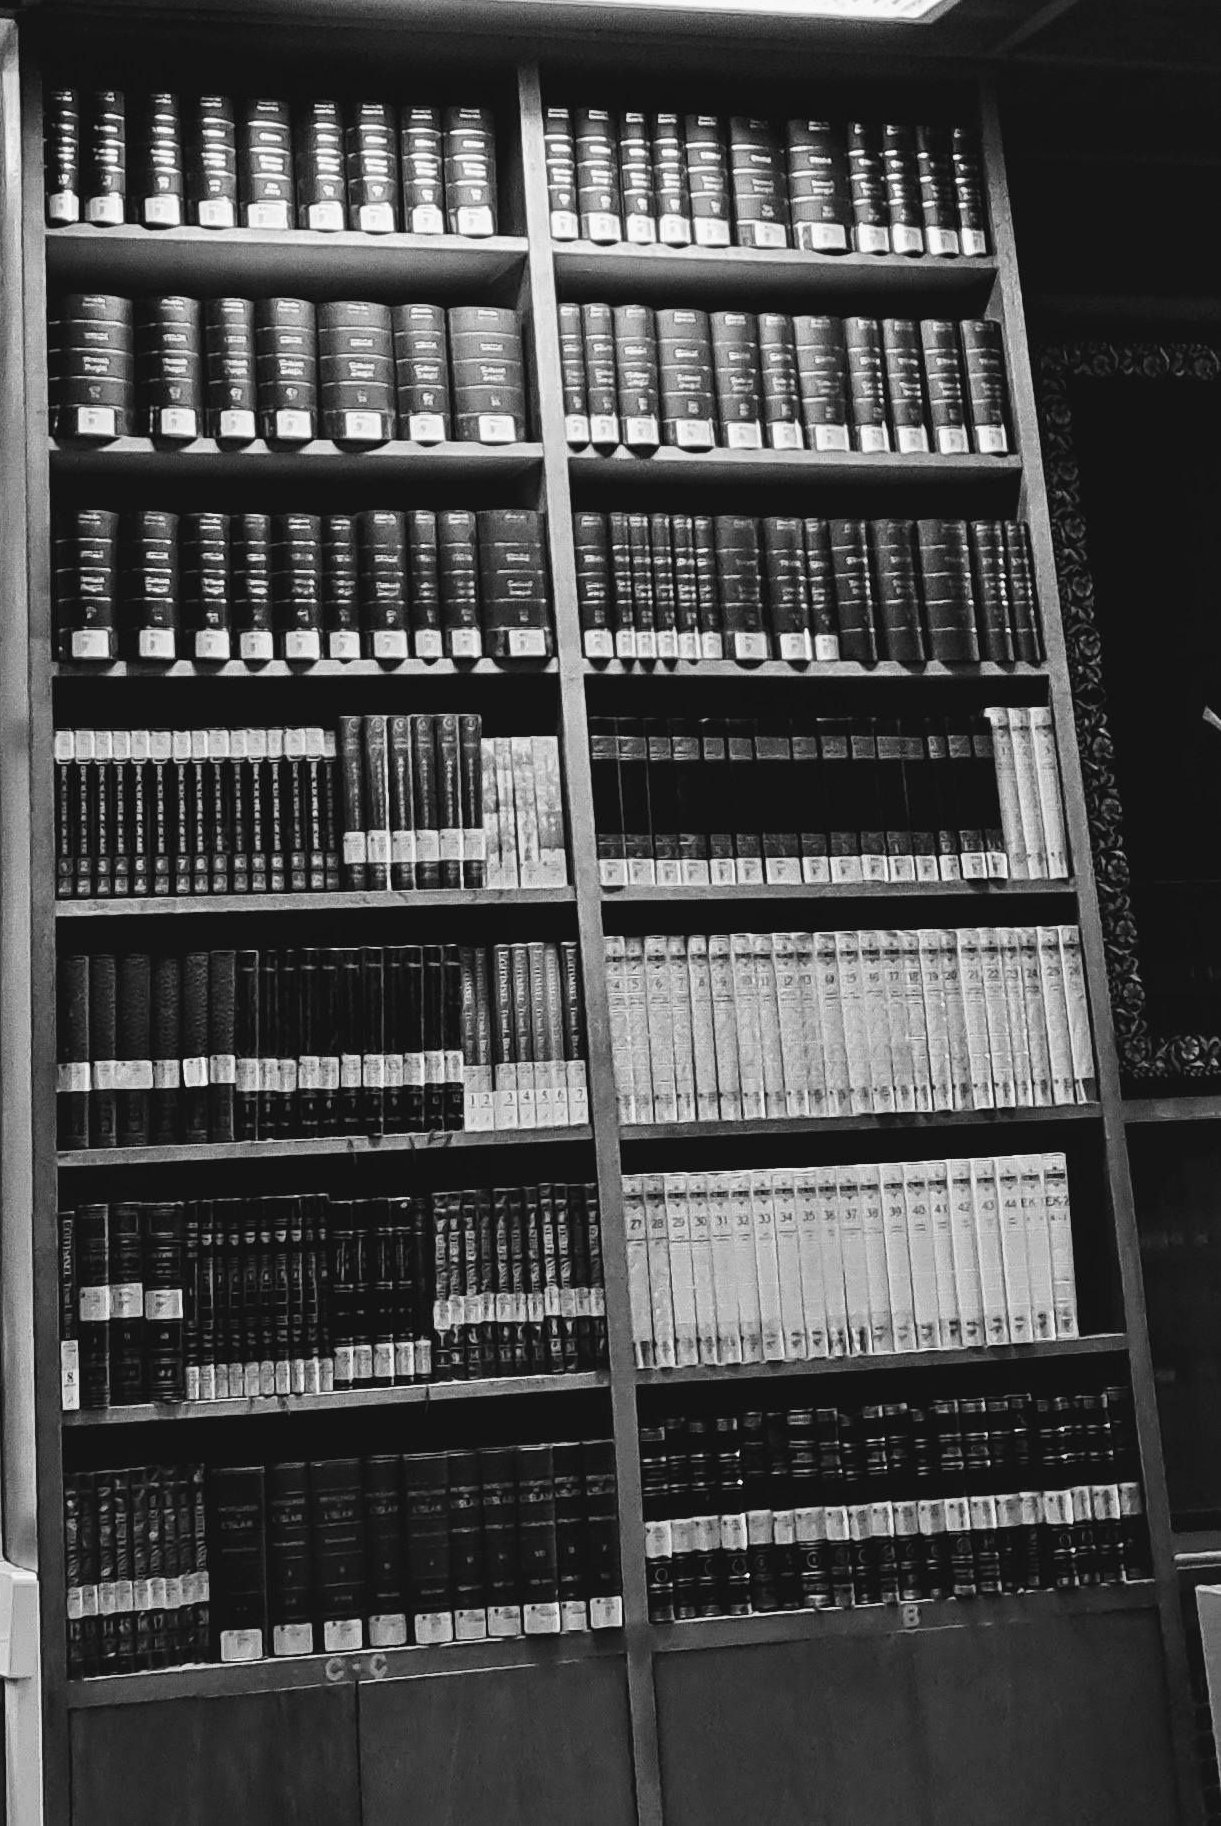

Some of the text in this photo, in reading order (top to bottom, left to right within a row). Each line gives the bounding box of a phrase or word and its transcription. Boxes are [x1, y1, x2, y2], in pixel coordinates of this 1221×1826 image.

[889, 971, 899, 981] 17
[968, 970, 979, 979] 21
[987, 969, 999, 979] 22
[1007, 969, 1019, 979] 23
[1026, 968, 1038, 978] 24
[614, 981, 620, 989] 4
[632, 980, 639, 989] 5
[655, 979, 663, 988] 6
[483, 1093, 490, 1105] 2
[507, 1091, 513, 1103] 3
[523, 1090, 531, 1101] 4
[541, 1089, 548, 1101] 5
[557, 1089, 565, 1100] 6
[577, 1088, 584, 1100] 7
[470, 1094, 475, 1106] 1
[958, 1201, 971, 1212] 42
[982, 1200, 994, 1211] 43
[1005, 1199, 1017, 1208] 44
[1021, 1197, 1044, 1208] EK1
[845, 1208, 857, 1220] 37
[867, 1208, 878, 1218] 38
[889, 1206, 902, 1217] 39
[912, 1205, 926, 1215] 40
[934, 1204, 947, 1214] 41
[717, 1215, 728, 1226] 31
[736, 1215, 749, 1226] 32
[759, 1213, 771, 1224] 33
[780, 1212, 793, 1222] 34
[803, 1210, 815, 1222] 35
[824, 1210, 835, 1221] 36
[630, 1219, 642, 1230] 27
[651, 1218, 663, 1229] 28
[672, 1217, 685, 1227] 29
[694, 1216, 707, 1227] 30
[66, 1371, 73, 1383] 8
[903, 1604, 920, 1628] B
